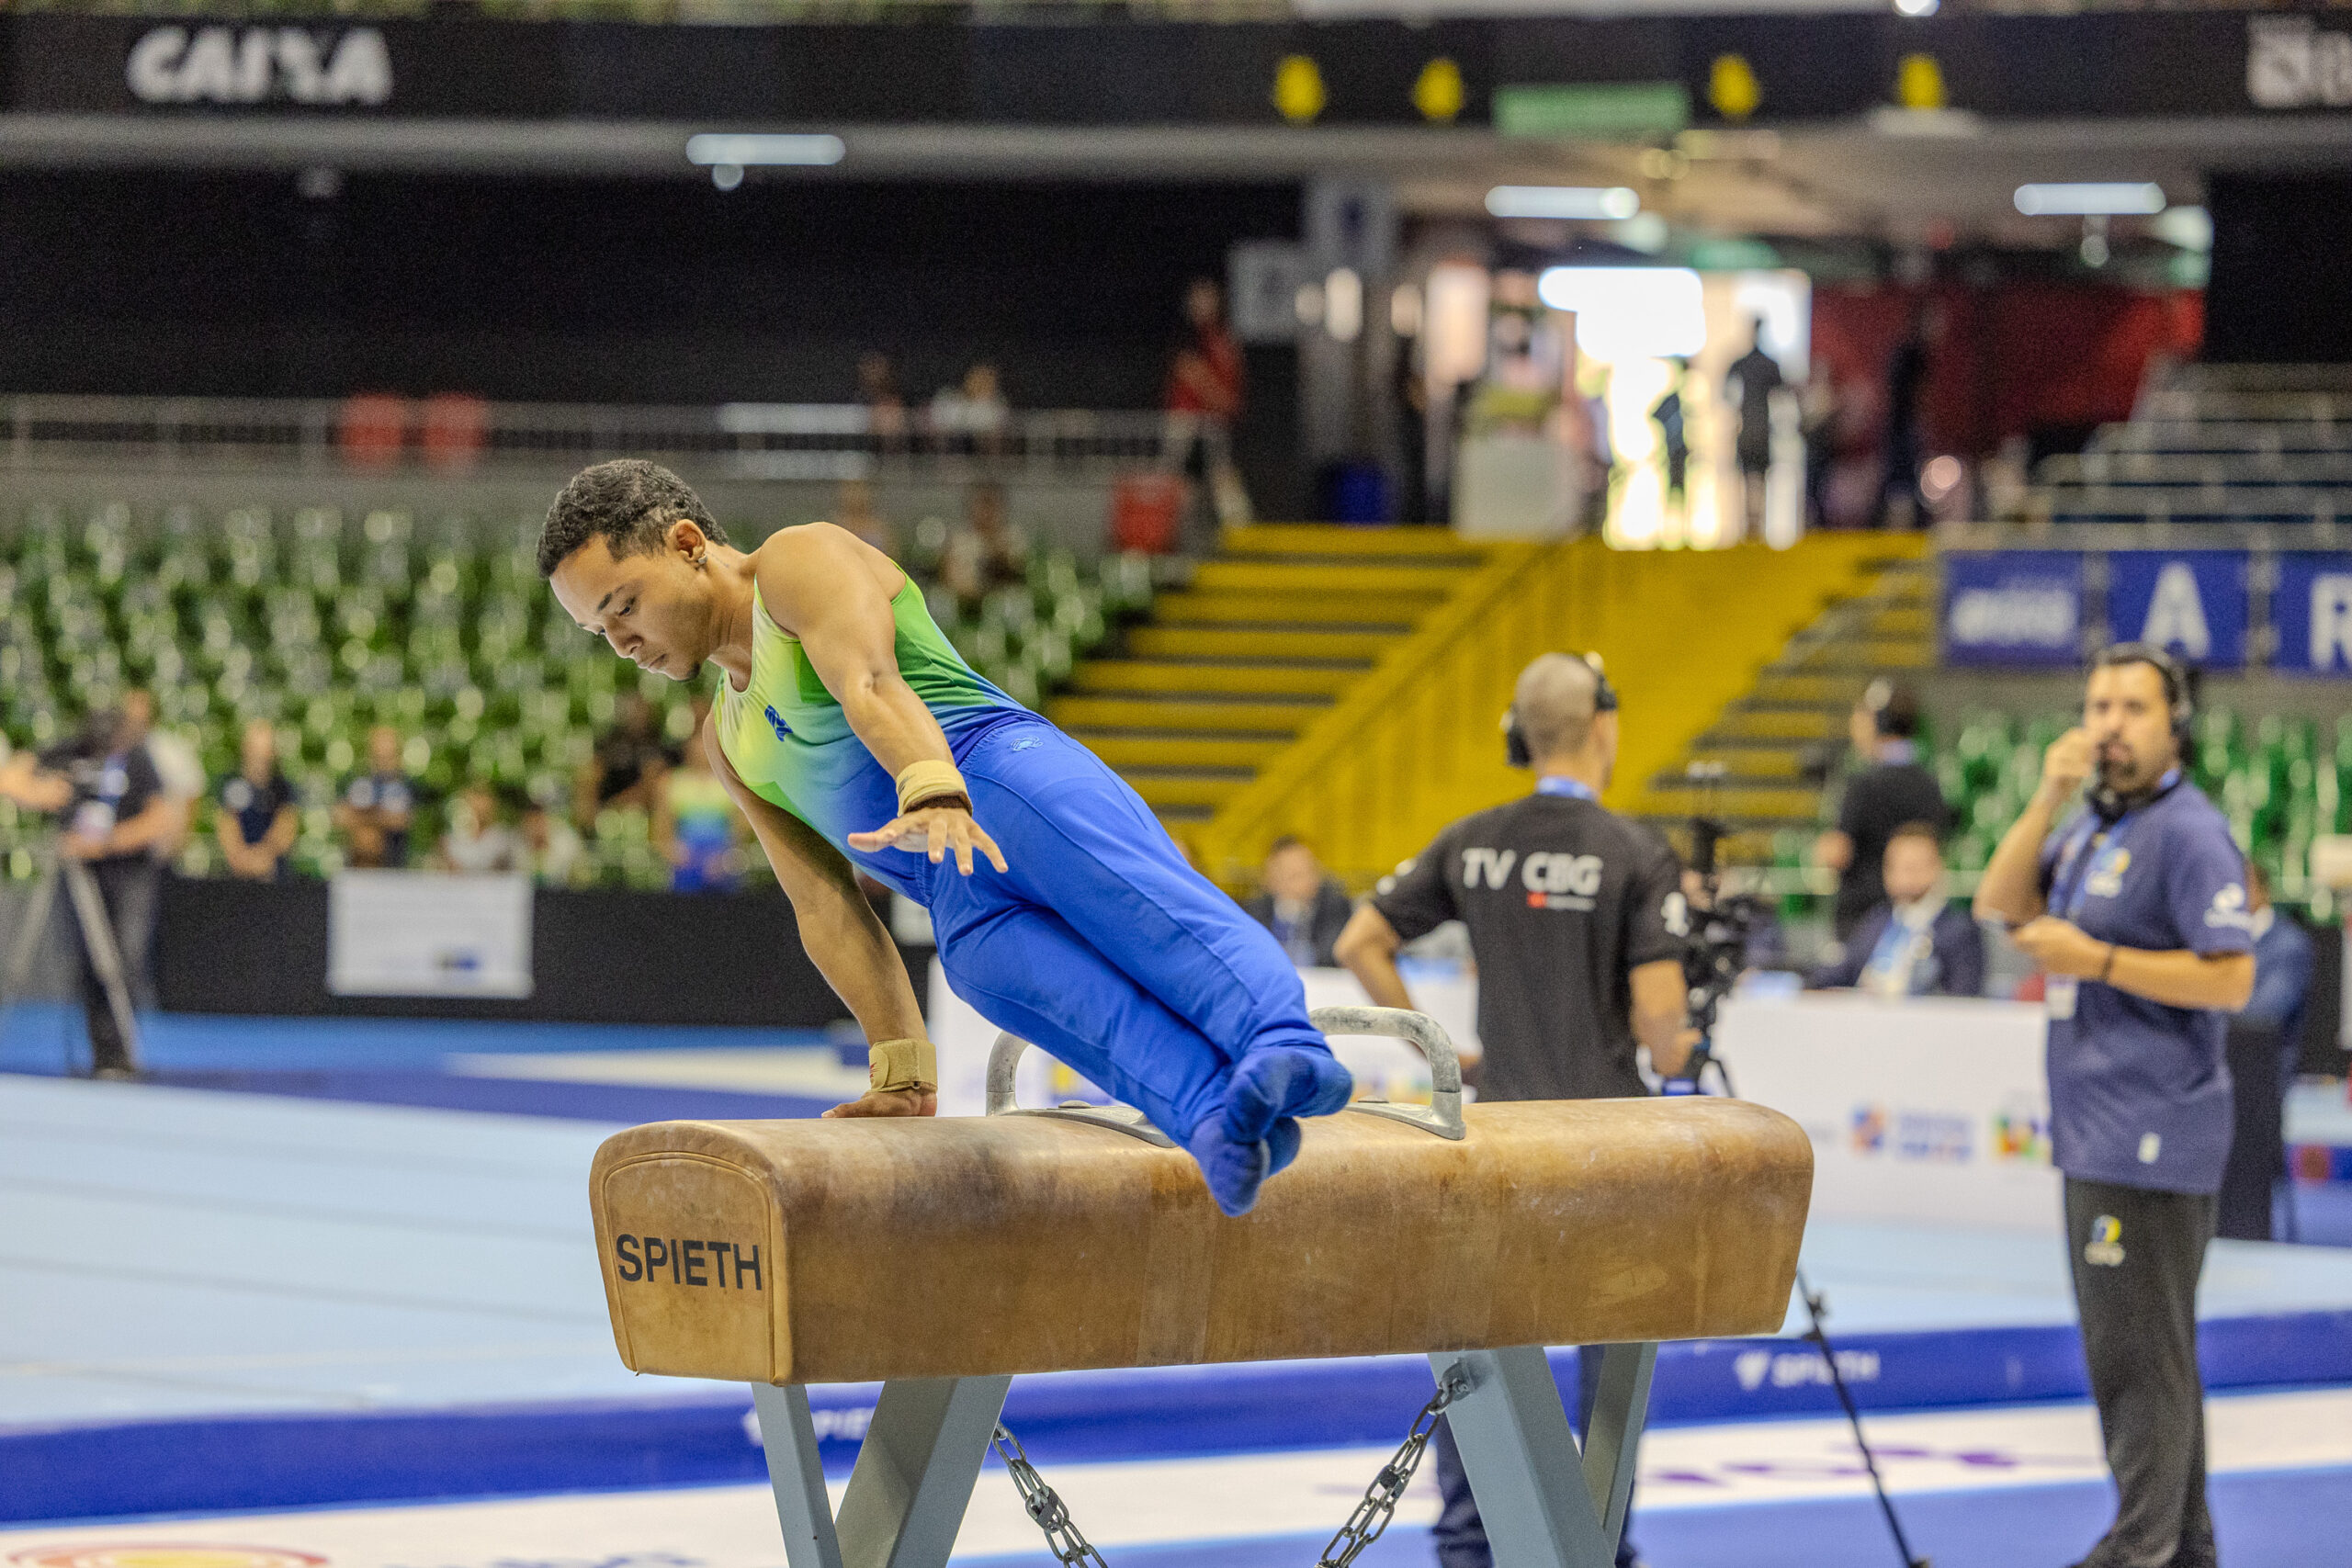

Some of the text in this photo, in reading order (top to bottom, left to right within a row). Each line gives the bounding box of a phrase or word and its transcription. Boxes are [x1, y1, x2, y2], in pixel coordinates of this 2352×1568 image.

[128, 26, 393, 104] CAIXA
[2140, 561, 2210, 660] A
[1461, 847, 1604, 896] TV CBG
[616, 1234, 763, 1291] SPIETH
